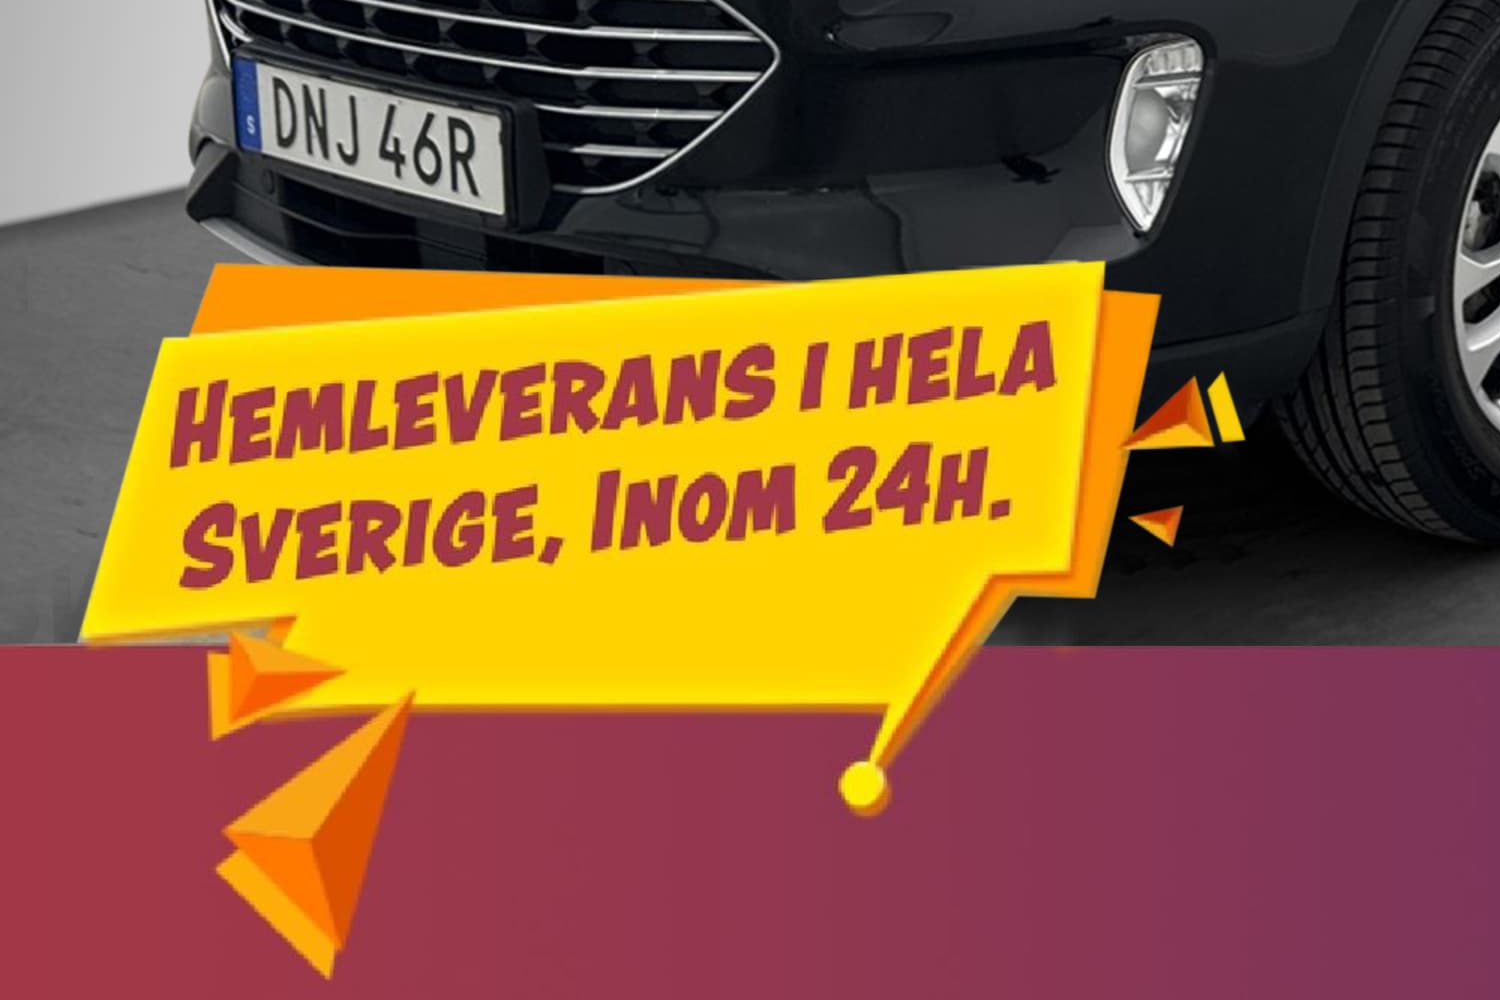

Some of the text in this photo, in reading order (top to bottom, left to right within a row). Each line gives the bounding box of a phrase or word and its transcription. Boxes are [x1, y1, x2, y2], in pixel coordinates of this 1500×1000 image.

[246, 114, 256, 135] S
[272, 77, 480, 197] DNJ 46R
